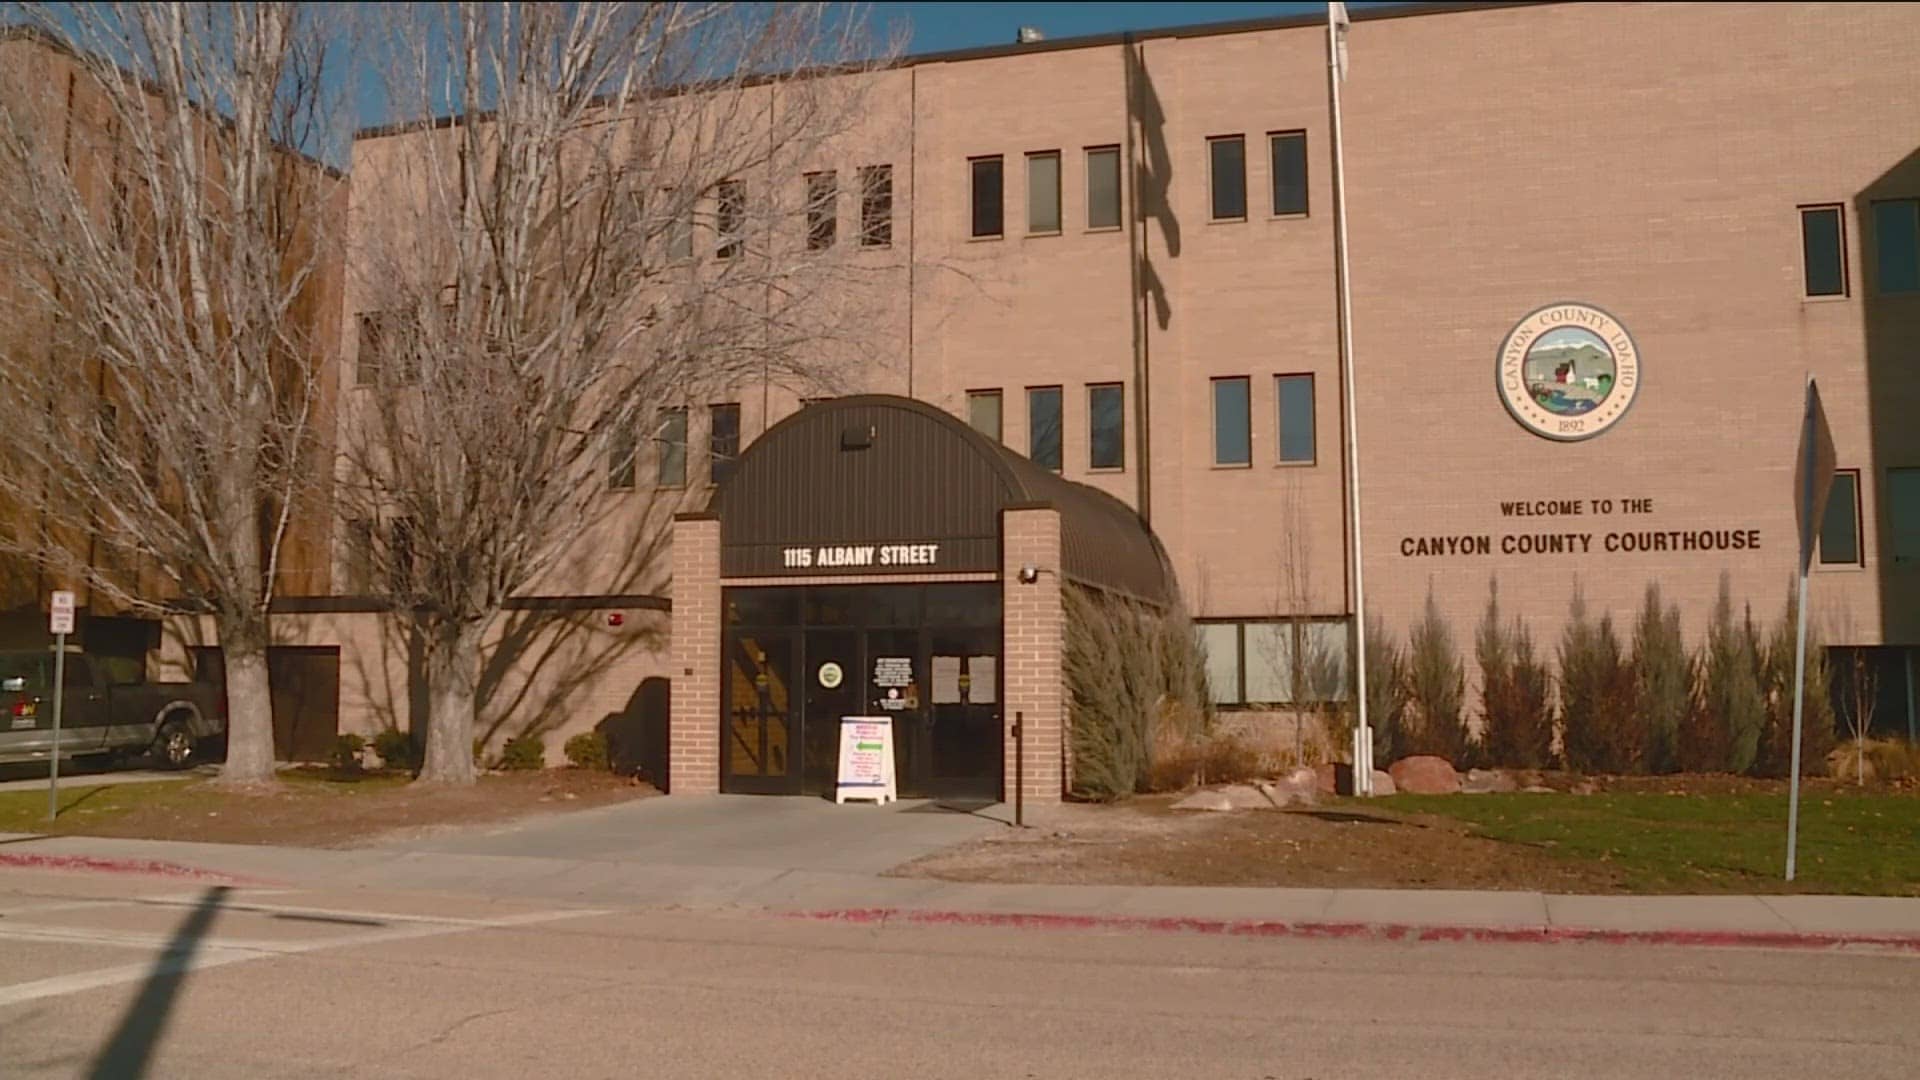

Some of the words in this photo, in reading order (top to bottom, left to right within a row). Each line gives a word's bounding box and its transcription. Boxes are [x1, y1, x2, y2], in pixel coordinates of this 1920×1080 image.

[1506, 328, 1533, 390] CANYON
[1539, 308, 1609, 329] COUNTY
[1559, 420, 1584, 432] 1892
[1501, 501, 1582, 516] WELCOME
[1592, 500, 1612, 514] TO
[1622, 499, 1653, 513] THE
[1401, 536, 1490, 556] CANYON
[1502, 534, 1592, 554] COUNTY
[1604, 530, 1761, 552] COURTHOUSE
[784, 549, 812, 567] 1115
[817, 547, 875, 566] ALBANY
[879, 545, 938, 565] STREET
